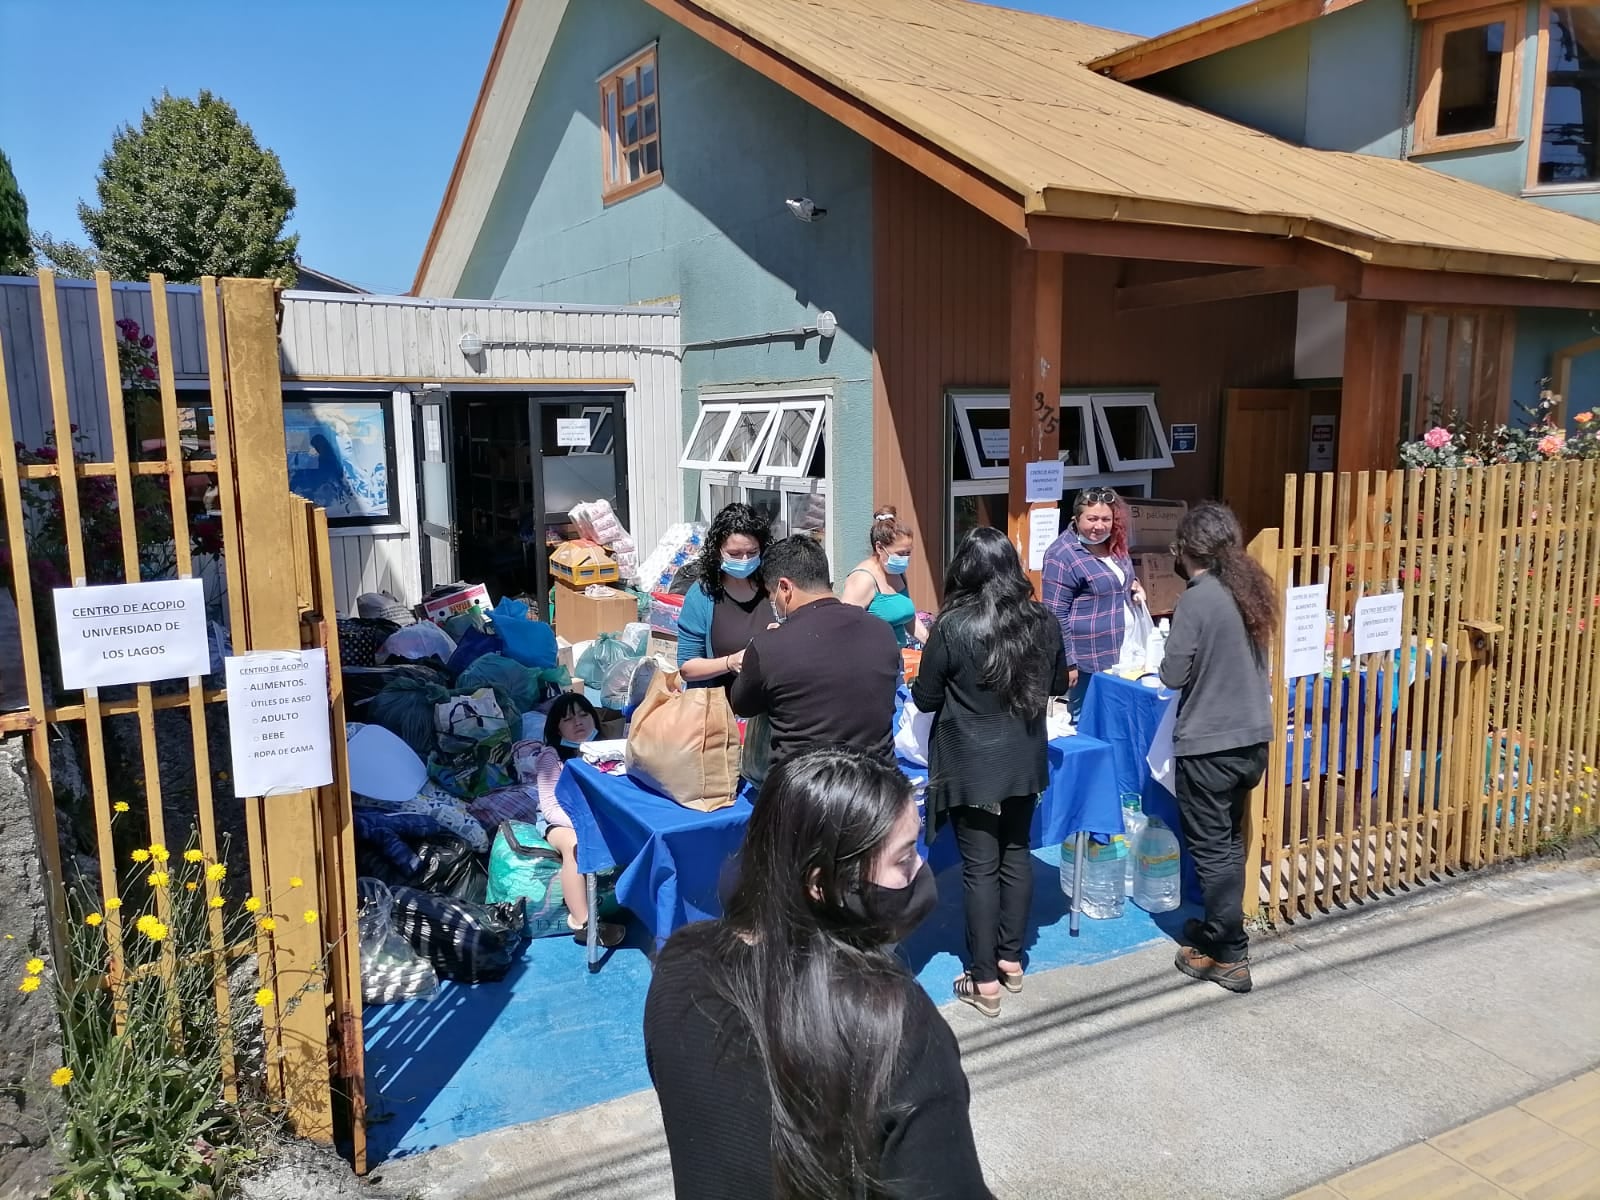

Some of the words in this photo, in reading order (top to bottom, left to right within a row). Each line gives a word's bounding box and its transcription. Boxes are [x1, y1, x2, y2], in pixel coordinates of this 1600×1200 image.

[72, 605, 120, 617] CENTRO
[123, 604, 139, 613] DE
[141, 600, 185, 611] ACOPIO
[82, 623, 162, 638] UNIVERSIDAD
[165, 621, 181, 631] DE
[102, 649, 124, 660] LOS
[127, 645, 166, 657] LAGOS
[240, 666, 269, 675] CENTRO
[281, 662, 309, 670] ACOPIO
[279, 697, 289, 705] DE
[291, 694, 311, 703] ASEO
[261, 712, 299, 723] ADULTO
[262, 731, 285, 741] BEBE
[254, 750, 276, 758] ROPA
[290, 744, 314, 754] CAMA
